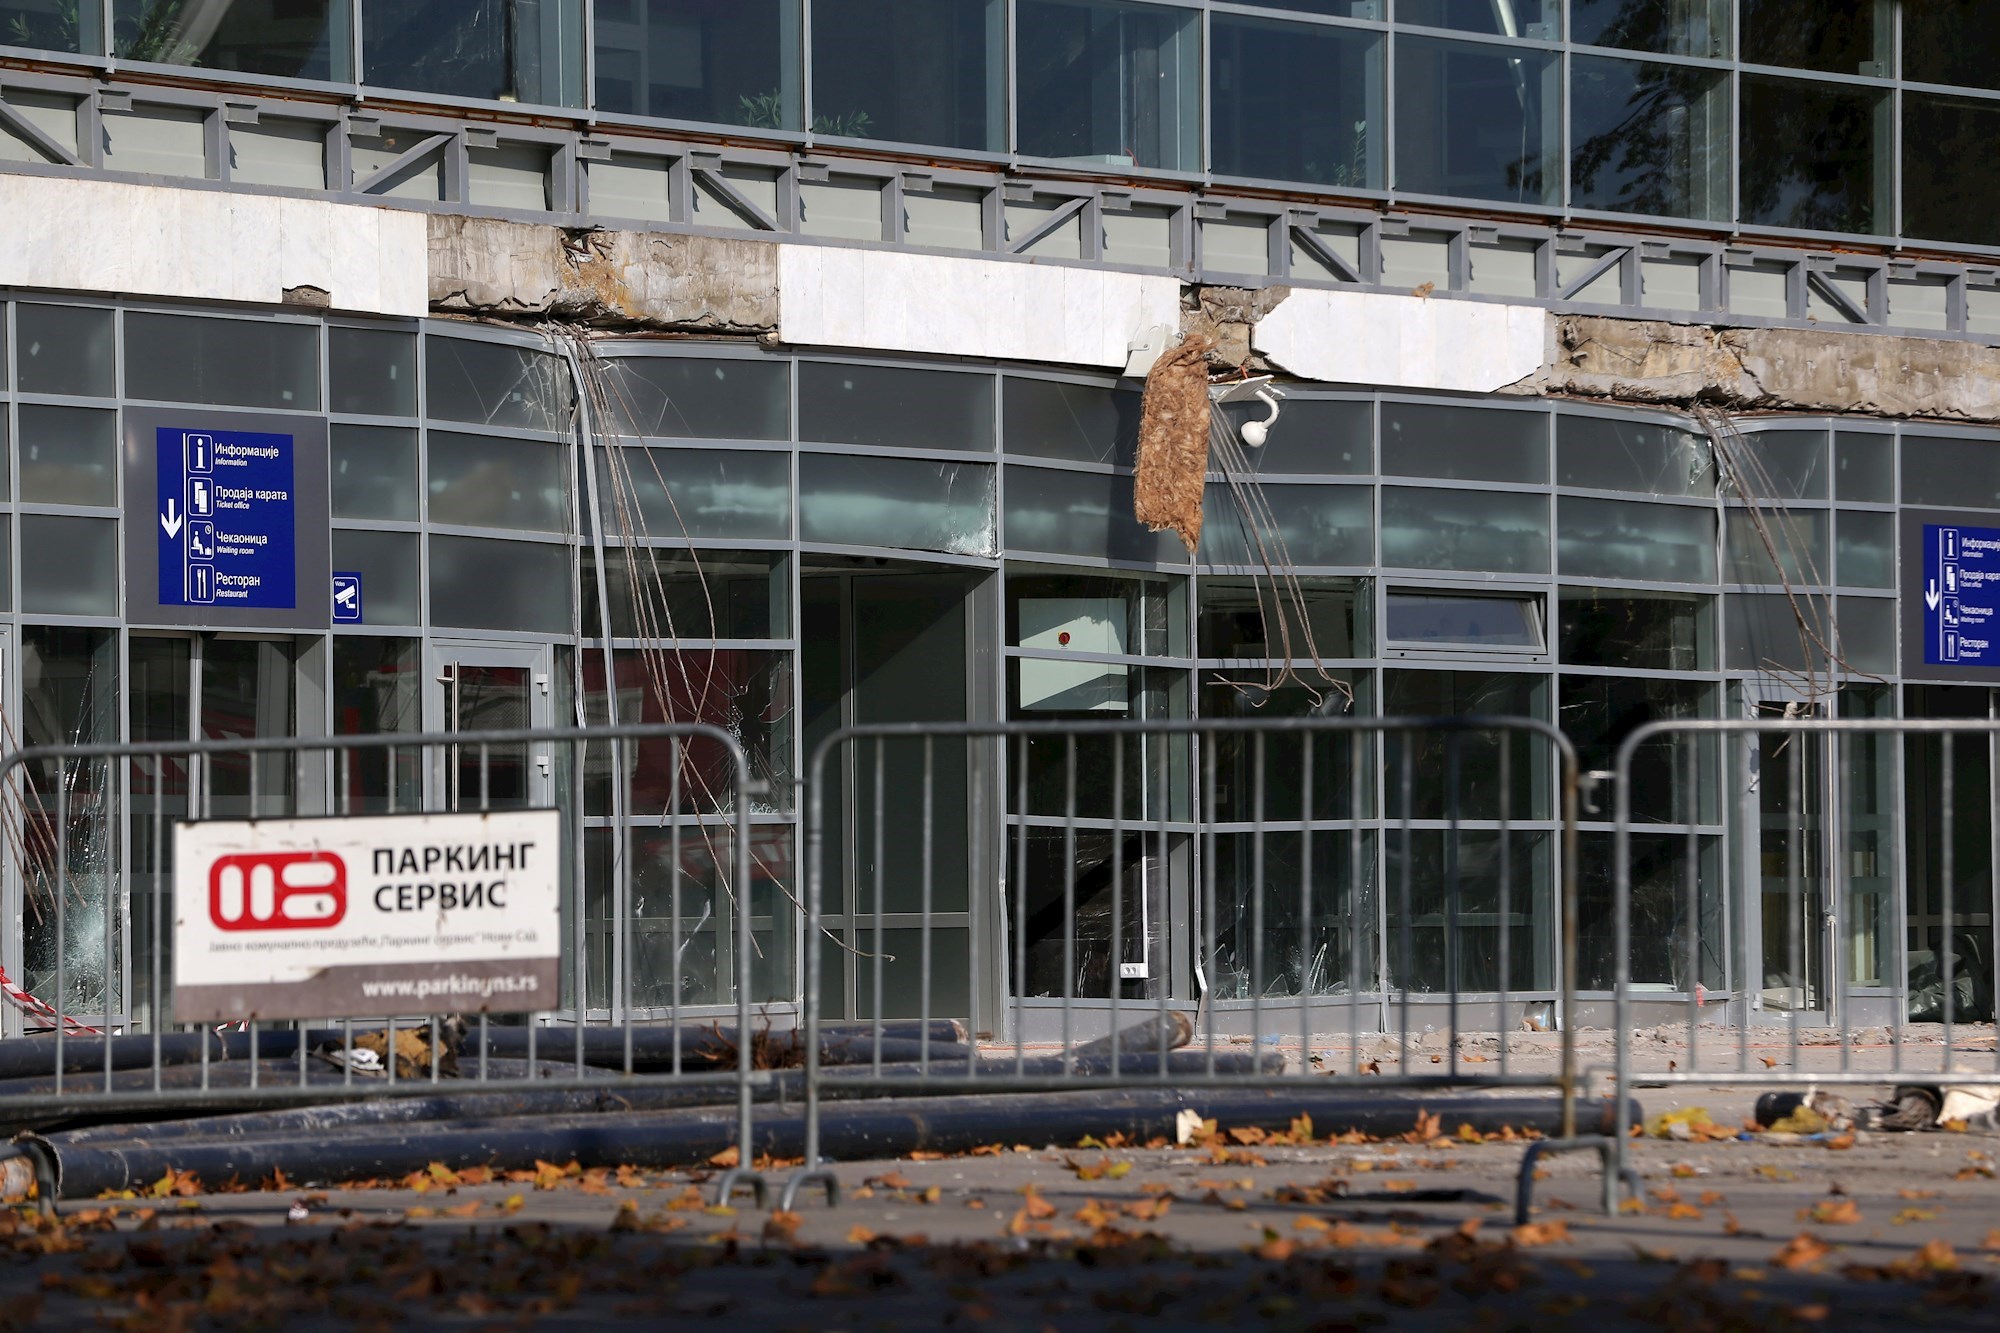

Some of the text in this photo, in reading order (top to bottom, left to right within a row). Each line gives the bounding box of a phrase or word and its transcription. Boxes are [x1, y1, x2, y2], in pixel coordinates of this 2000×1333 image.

[215, 442, 279, 460] Информације
[215, 457, 248, 467] Information
[215, 485, 288, 503] Продаја карата
[216, 500, 250, 510] Ticket office
[216, 530, 268, 546] Чекаоница
[1961, 537, 2000, 552] Информациј
[216, 545, 238, 556] Waiting
[215, 571, 261, 589] Ресторан
[215, 588, 248, 599] Restaurant
[371, 840, 536, 876] ПАРКИНГ
[373, 880, 507, 913] СЕРВИС
